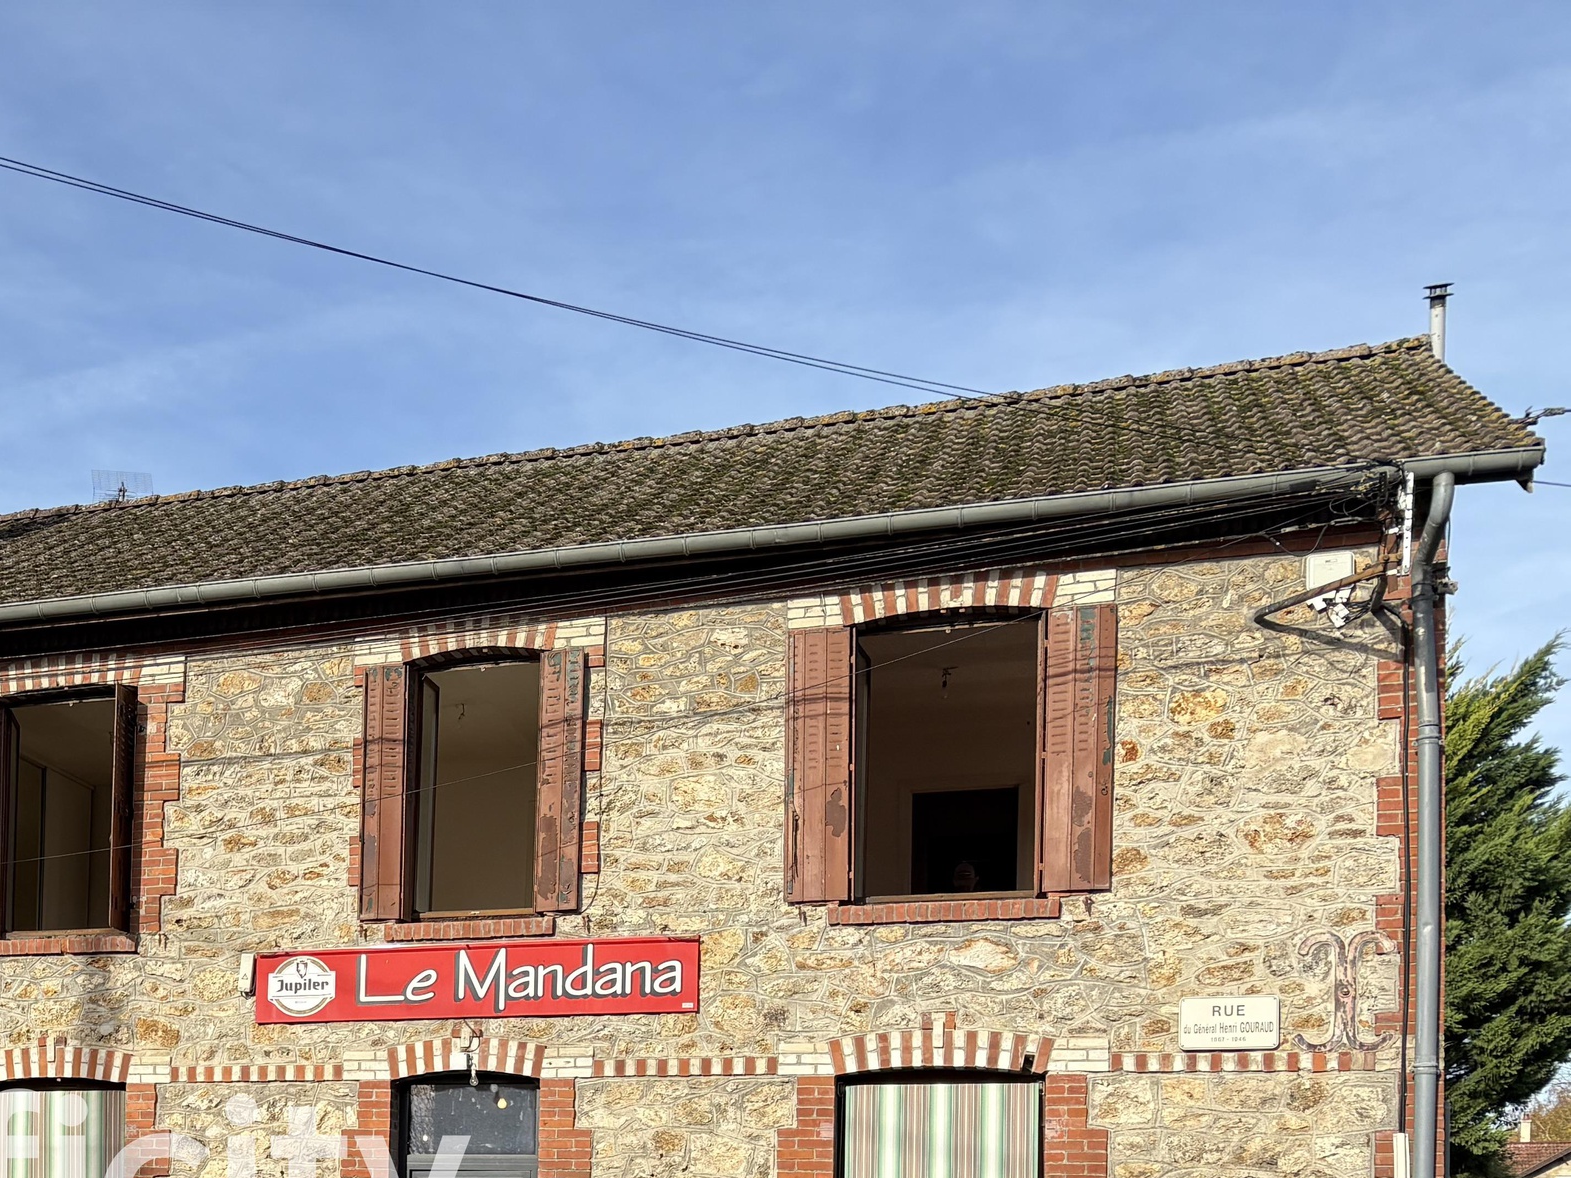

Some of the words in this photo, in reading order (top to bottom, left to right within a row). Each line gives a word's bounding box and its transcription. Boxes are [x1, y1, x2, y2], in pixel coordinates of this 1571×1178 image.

[356, 953, 438, 1005] Le
[454, 943, 683, 1014] Mandana
[276, 978, 329, 994] Jupiler
[1212, 1005, 1245, 1016] RUE
[1183, 1025, 1191, 1034] du
[1193, 1023, 1217, 1034] Général
[1219, 1022, 1237, 1033] Henri
[1240, 1021, 1274, 1033] GOURAUD
